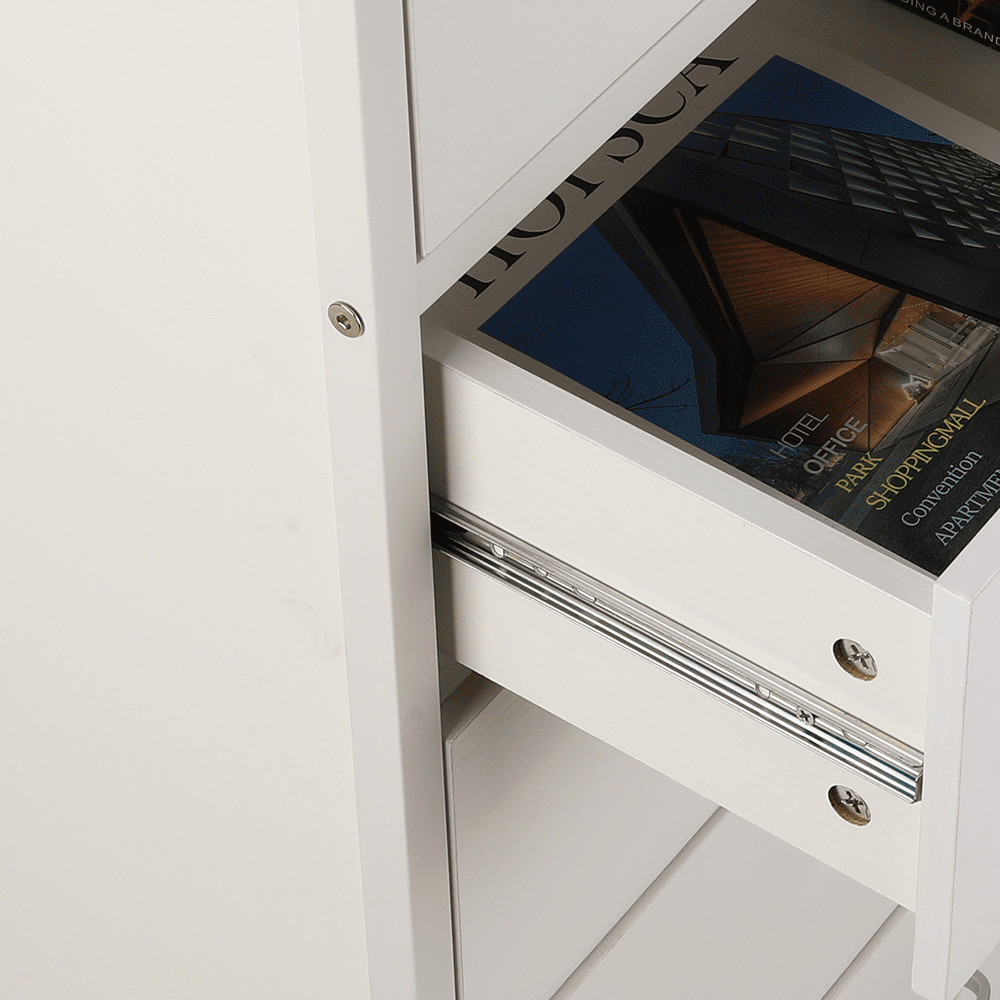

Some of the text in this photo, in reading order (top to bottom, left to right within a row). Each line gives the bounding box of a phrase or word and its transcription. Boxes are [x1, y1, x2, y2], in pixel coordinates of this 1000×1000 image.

[939, 12, 950, 23] A
[769, 412, 830, 460] HOTEL
[803, 416, 868, 475] OFFICE
[866, 398, 987, 511] SHOPPINGMALL
[835, 450, 884, 493] PARK
[901, 451, 984, 527] Convention
